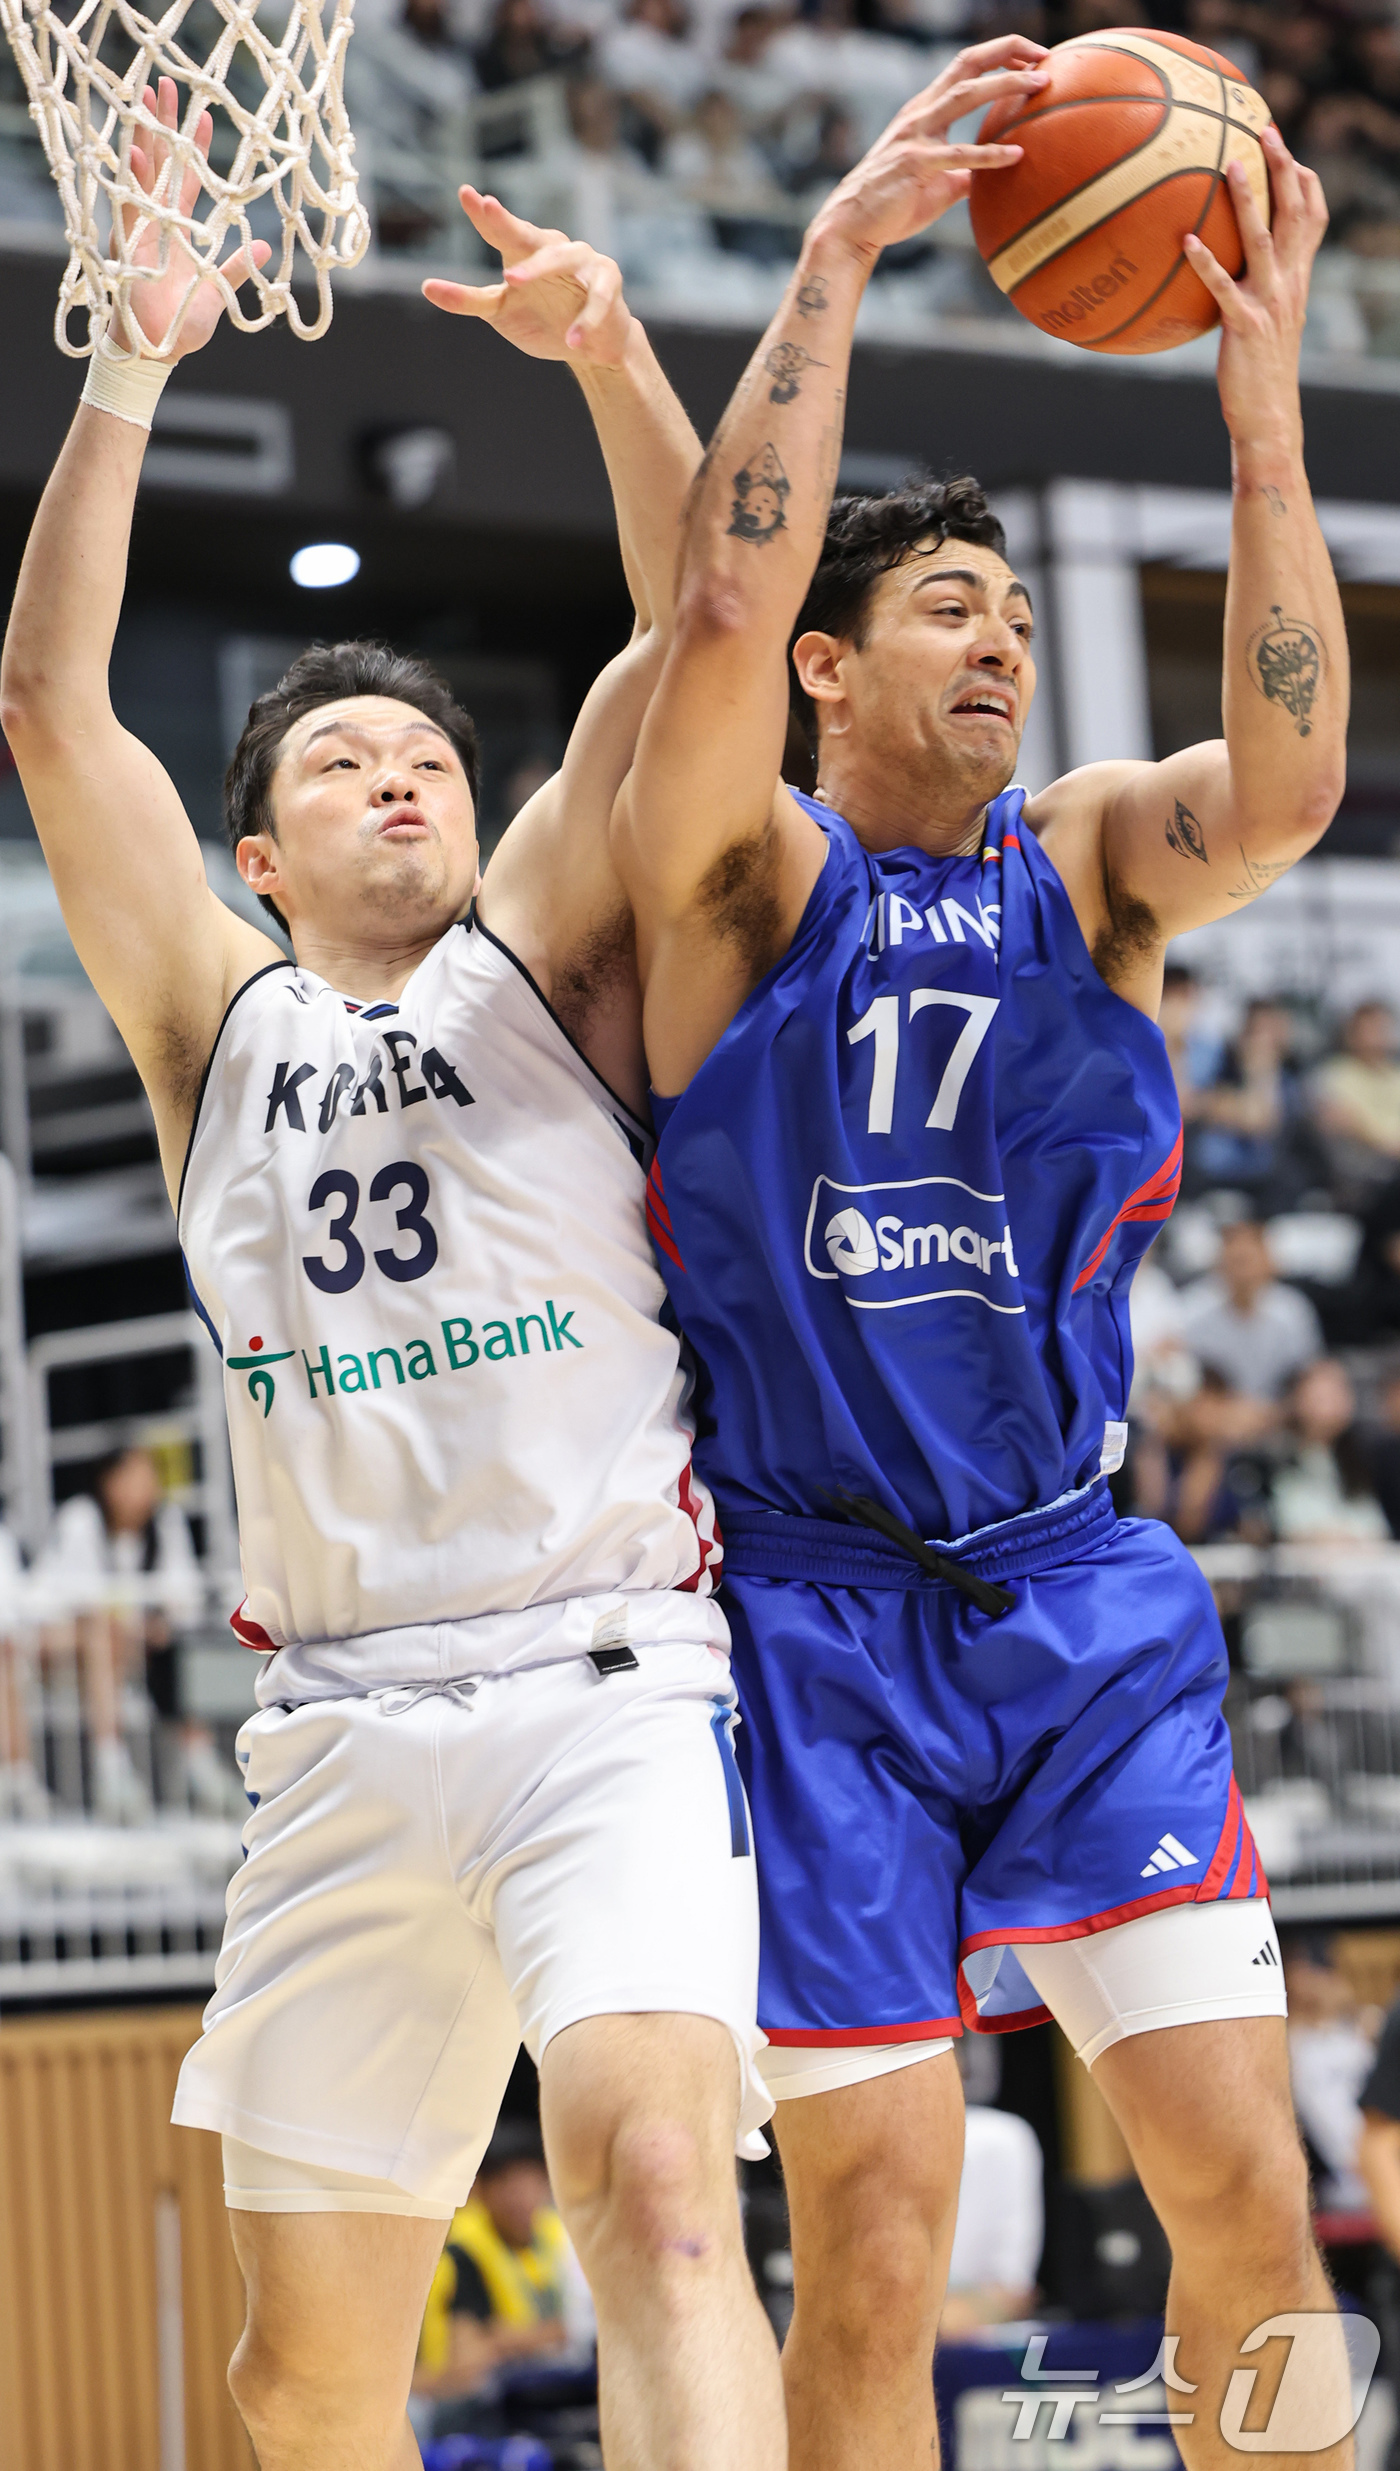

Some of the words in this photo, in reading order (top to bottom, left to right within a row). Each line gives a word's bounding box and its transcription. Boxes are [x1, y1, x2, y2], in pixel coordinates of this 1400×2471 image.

[1040, 256, 1140, 331] molten
[264, 1030, 476, 1134] KOREA
[846, 988, 1001, 1134] 17
[302, 1160, 438, 1294] 33
[874, 1215, 1020, 1278] Smart
[301, 1338, 439, 1399] Hana
[440, 1300, 585, 1372] Bank
